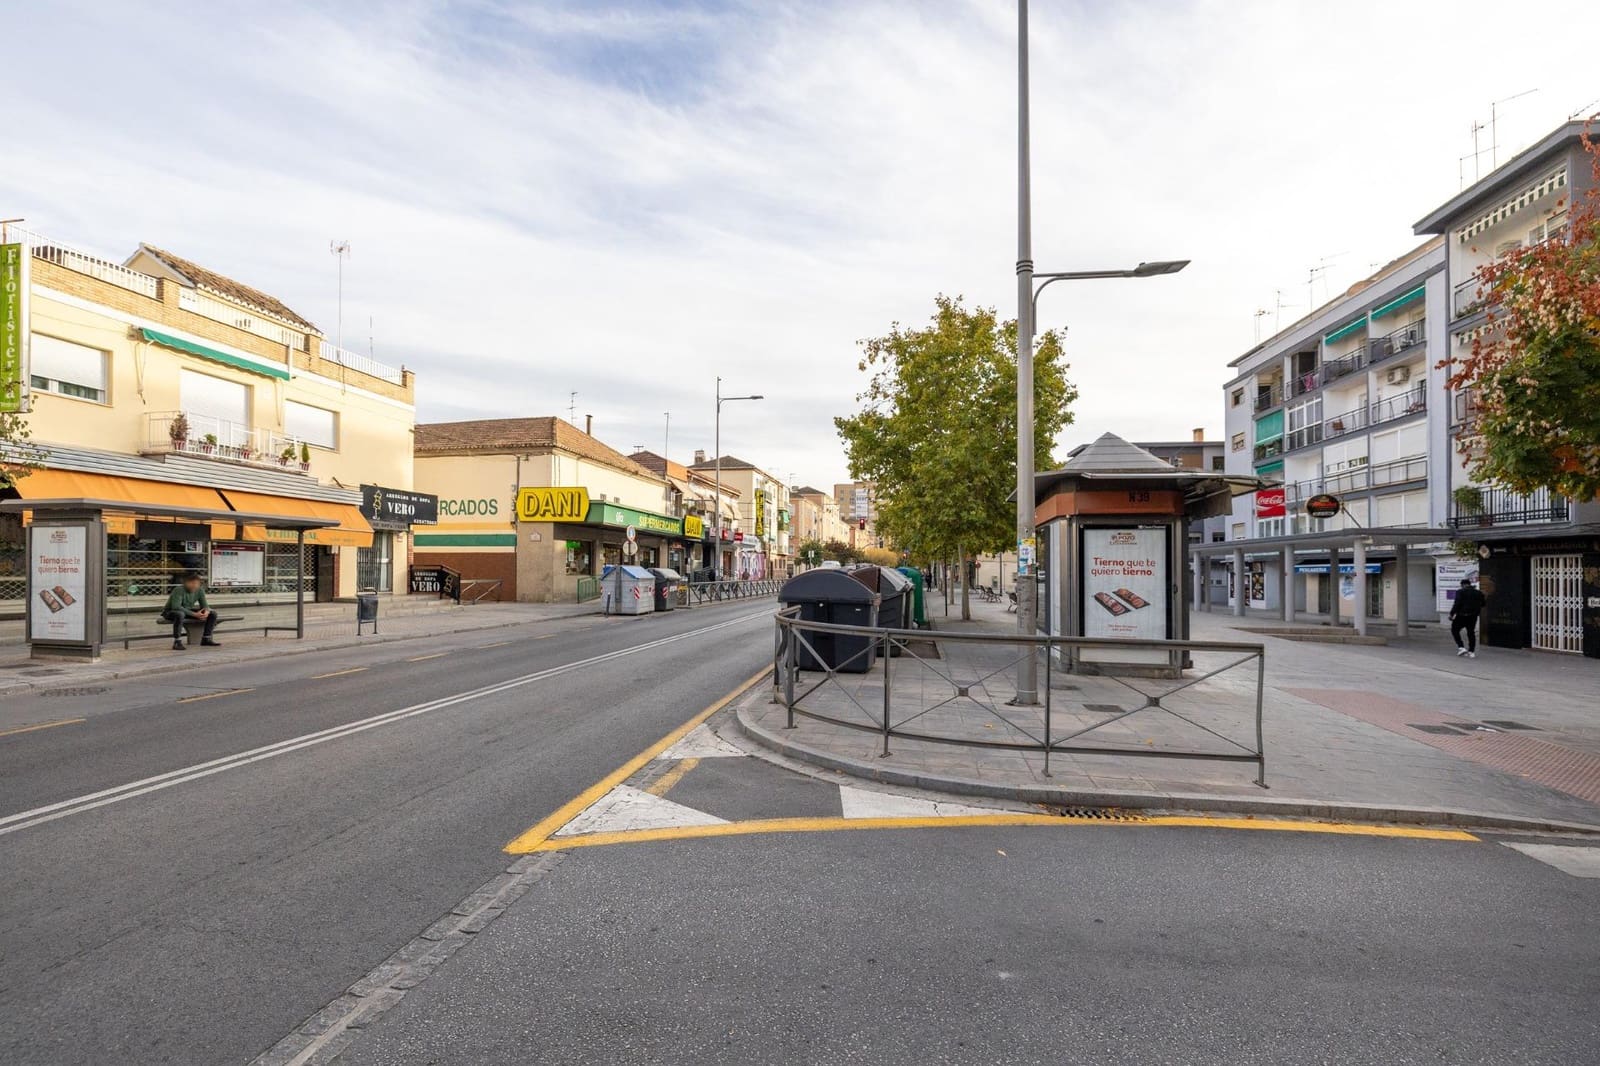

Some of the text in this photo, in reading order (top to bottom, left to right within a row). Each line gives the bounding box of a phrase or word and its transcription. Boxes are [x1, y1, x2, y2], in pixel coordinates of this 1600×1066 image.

[523, 491, 581, 518] DANI
[1257, 495, 1284, 505] Coca-Cola
[387, 502, 415, 516] VERO
[438, 499, 498, 516] RCADOS
[639, 515, 680, 533] SUPERMERCADOS
[686, 517, 702, 536] DANI
[40, 555, 80, 567] Tierno que te
[1093, 557, 1156, 570] Tierno que te
[38, 566, 57, 575] quiero
[1091, 567, 1154, 577] quiero tierno.
[412, 581, 440, 592] VERO
